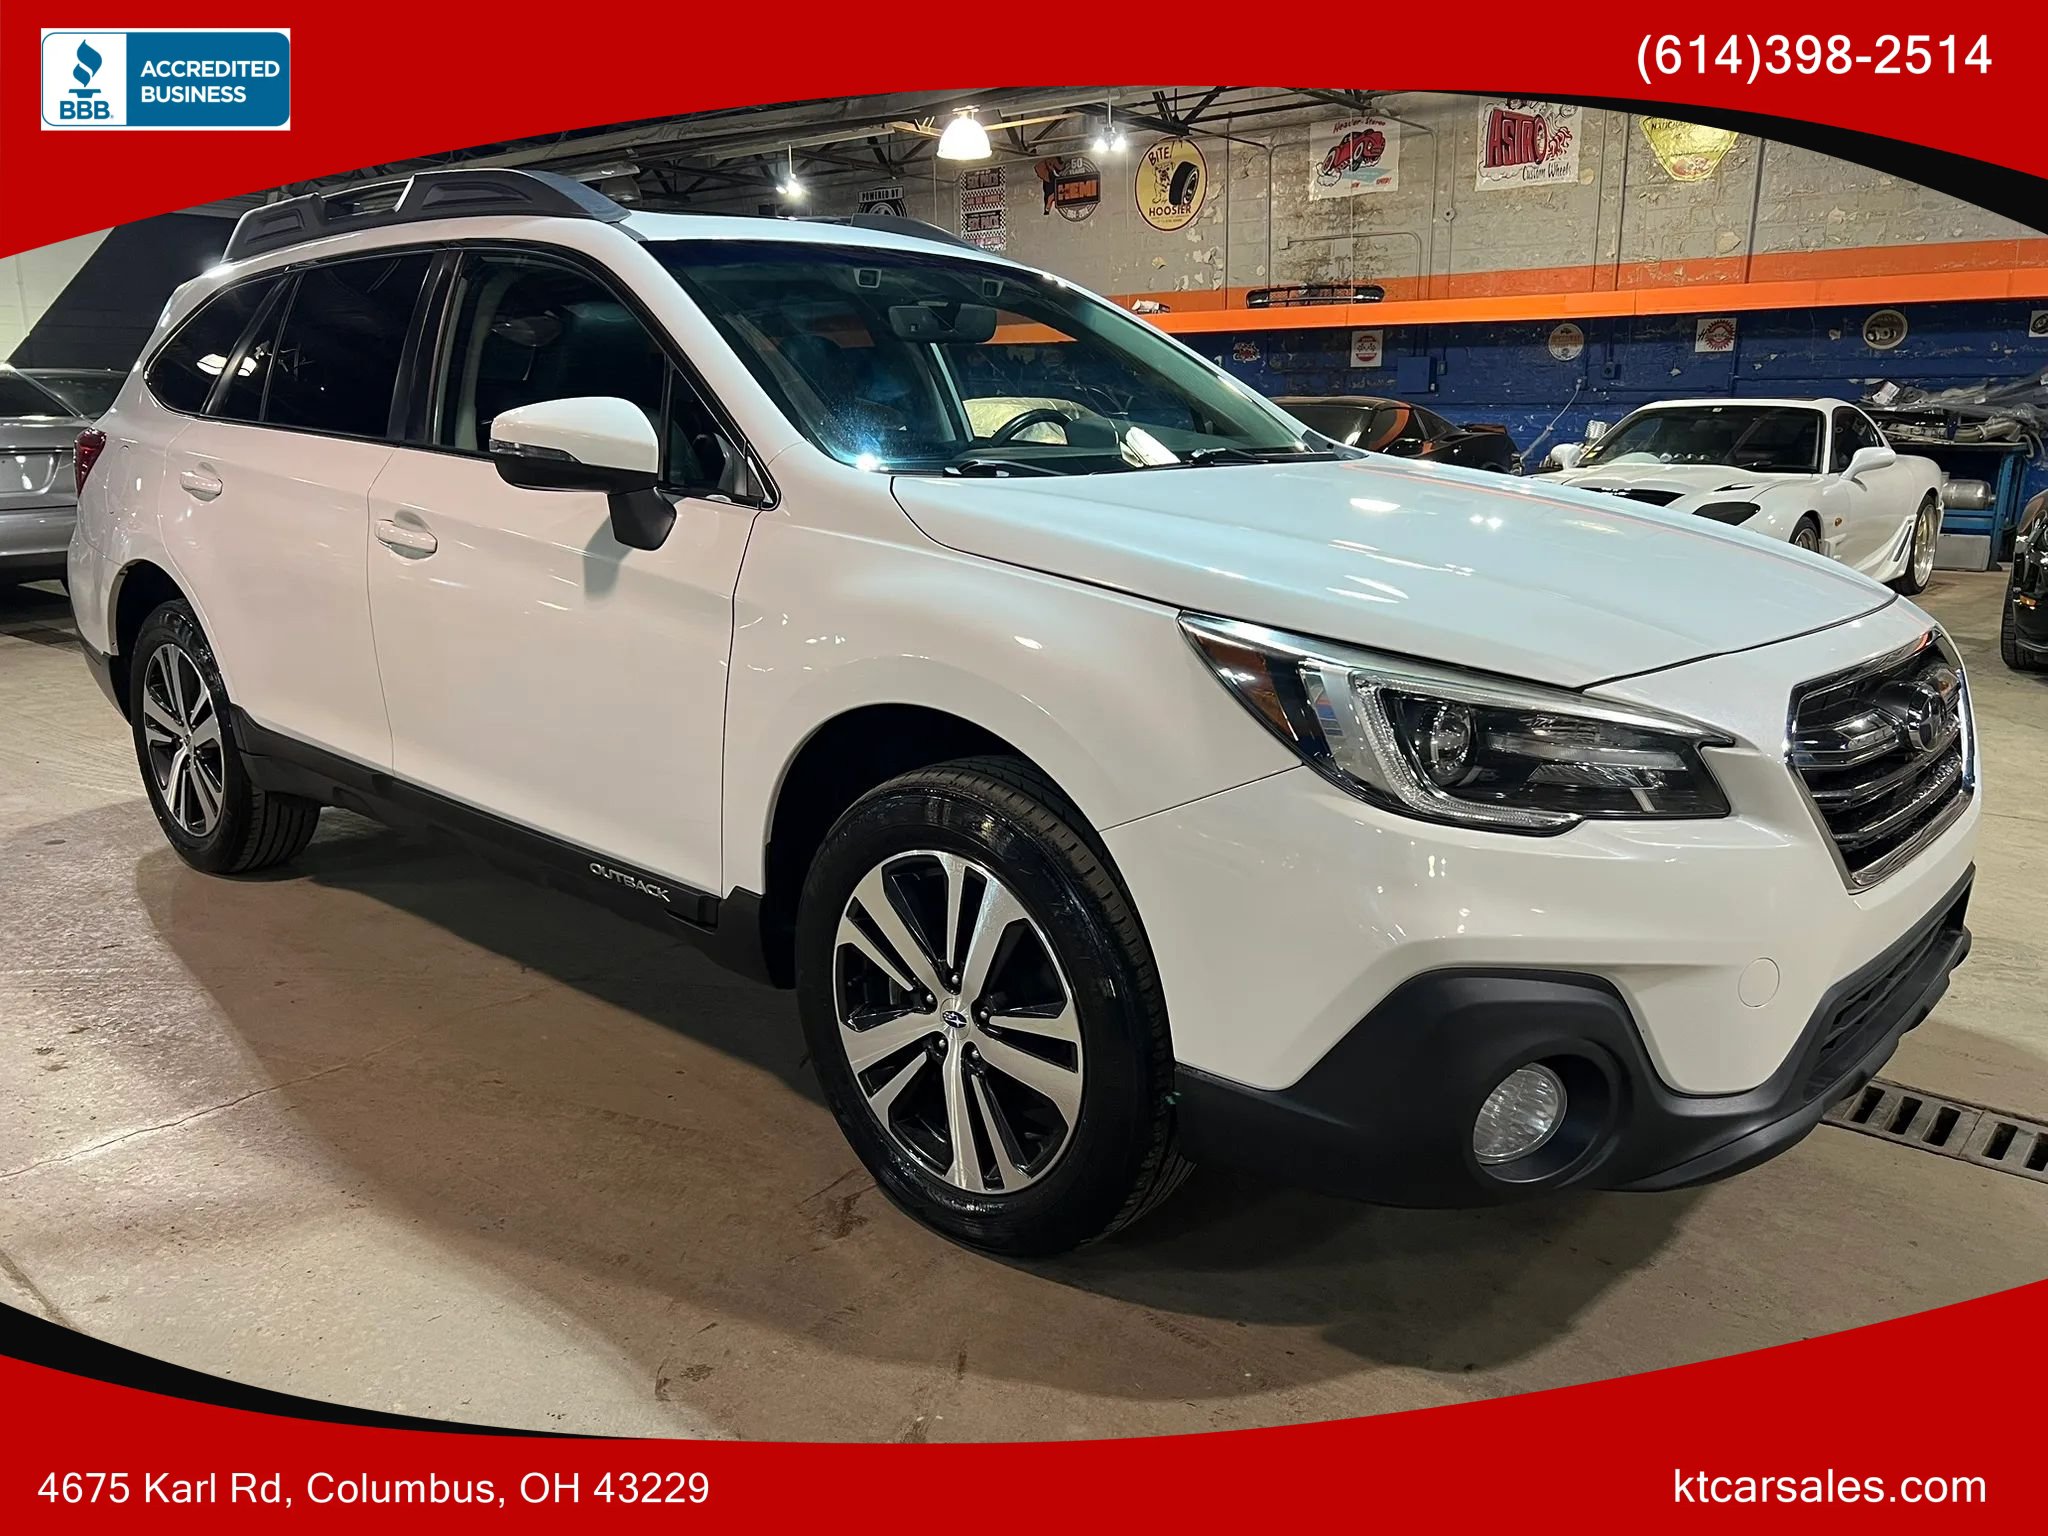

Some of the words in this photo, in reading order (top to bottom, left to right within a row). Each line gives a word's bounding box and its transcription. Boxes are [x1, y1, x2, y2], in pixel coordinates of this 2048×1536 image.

[1485, 107, 1548, 168] ASTRO
[1522, 166, 1546, 181] Custom
[1548, 162, 1571, 178] Wheels
[861, 190, 889, 201] POWERED
[891, 188, 899, 198] BY
[1057, 179, 1097, 201] HEMI
[1149, 204, 1192, 217] HOOSIER
[589, 862, 671, 903] OUTBACK
